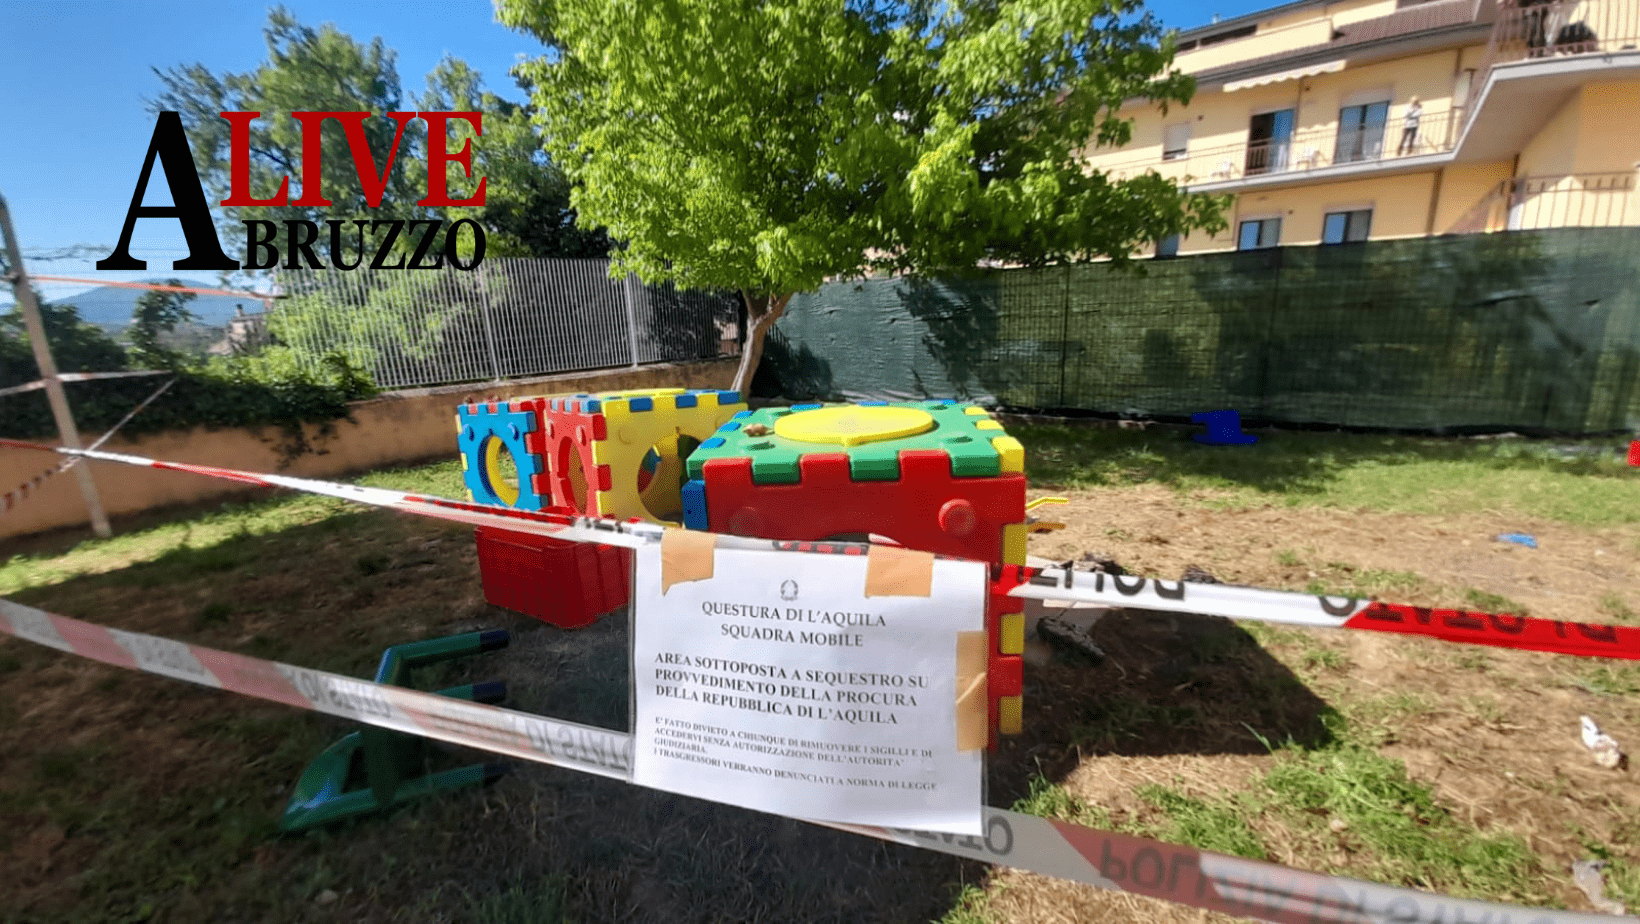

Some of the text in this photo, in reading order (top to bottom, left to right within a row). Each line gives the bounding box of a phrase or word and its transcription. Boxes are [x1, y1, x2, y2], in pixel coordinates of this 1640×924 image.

[702, 601, 886, 628] QUESTURA DI L'AQUILA
[721, 623, 863, 647] SQUADRA MOBILE
[655, 653, 928, 688] AREA SOTTOPOSTA A SEQUESTRO SU
[655, 668, 917, 706] PROVVEDIMENTO DELLA PROCURA
[656, 685, 898, 725] DELLA REPUBBLICA DI L'AQUILA
[655, 728, 702, 743] ACCEDERVI
[703, 734, 731, 748] SENZA
[732, 741, 815, 760] AUTORIZZAZIONE
[664, 719, 692, 732] FATTO
[693, 723, 728, 736] DIVIETO
[729, 730, 737, 738] A
[737, 730, 786, 745] CHIUNQUE
[788, 738, 799, 748] DI
[800, 739, 862, 754] RIMUOVERE
[870, 745, 909, 757] SIGILLI
[911, 748, 918, 757] E
[921, 749, 932, 759] DI
[659, 748, 721, 768] TRASGRESSORI
[722, 760, 772, 776] VERRANNO
[774, 768, 835, 785] DENUNCIATI
[846, 778, 885, 788] NORMA
[887, 780, 899, 789] DI
[901, 781, 937, 791] LEGGE
